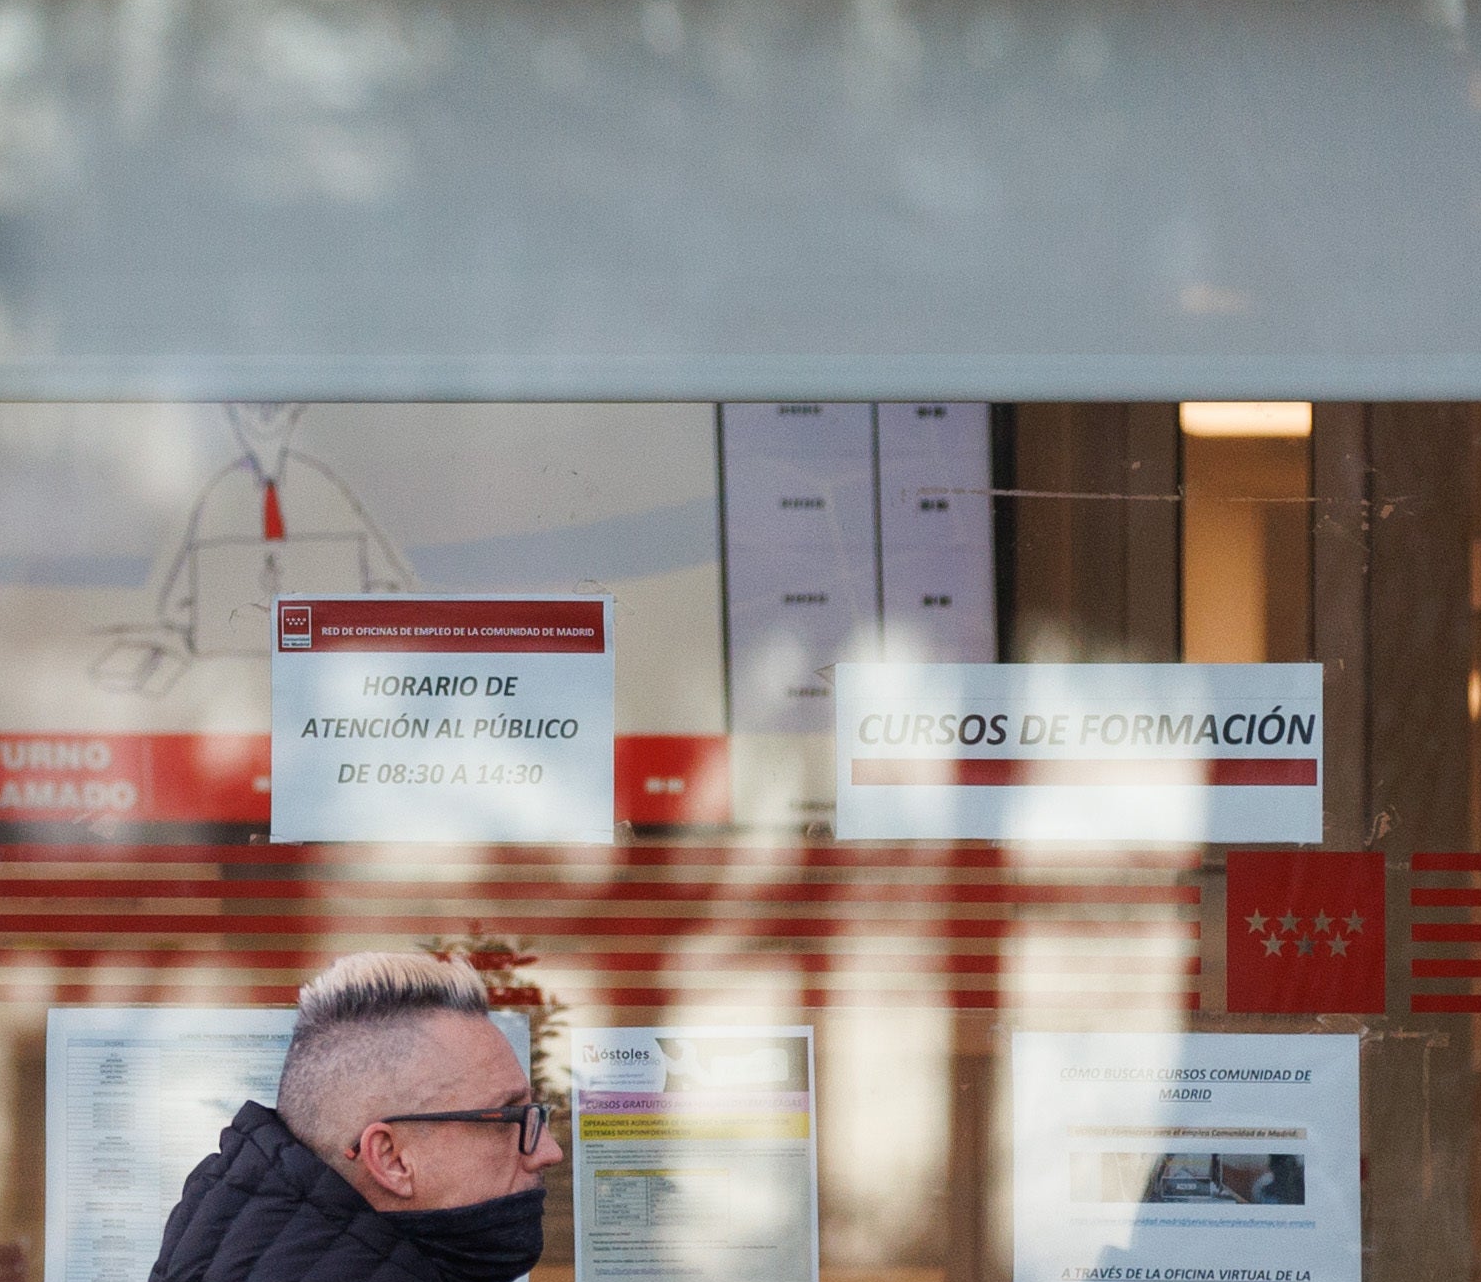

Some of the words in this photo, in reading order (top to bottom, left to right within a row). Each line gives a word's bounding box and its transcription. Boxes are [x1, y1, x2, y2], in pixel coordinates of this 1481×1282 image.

[363, 676, 478, 696] HORARIO
[485, 676, 519, 696] DE
[301, 713, 429, 739] ATENCIÓN
[437, 719, 465, 738] AL
[474, 713, 578, 738] PÚBLICO
[857, 713, 1008, 746] CURSOS
[1019, 714, 1066, 746] DE
[1078, 705, 1316, 746] FORMACIÓN
[337, 764, 371, 784] DE
[377, 764, 444, 784] 08:30
[450, 764, 467, 784] A
[476, 764, 543, 784] 14:30
[1062, 1269, 1071, 1278] A
[1076, 1266, 1122, 1279] TRAVÉS
[1126, 1268, 1142, 1279] DE
[1145, 1269, 1160, 1279] LA
[1164, 1269, 1215, 1280] OFICINA
[1219, 1269, 1271, 1281] VIRTUAL
[1275, 1270, 1292, 1281] DE
[1296, 1271, 1311, 1281] LA
